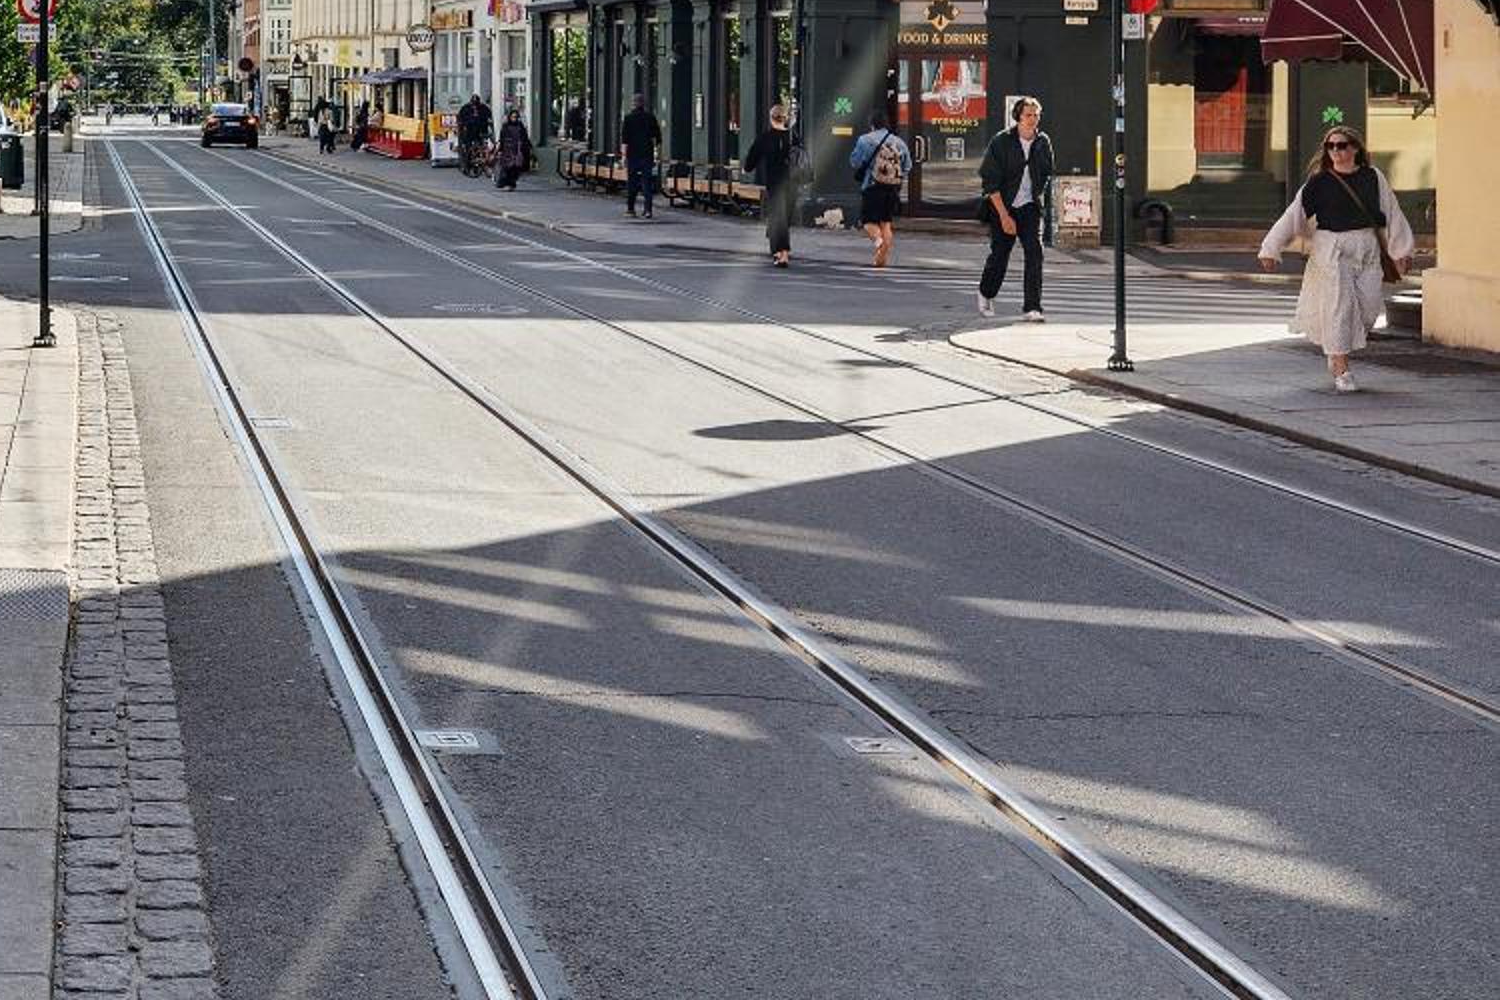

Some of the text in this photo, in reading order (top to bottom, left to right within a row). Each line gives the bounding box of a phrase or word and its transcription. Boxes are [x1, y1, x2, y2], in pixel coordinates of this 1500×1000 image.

[897, 33, 989, 46] FOOD & DRINKS
